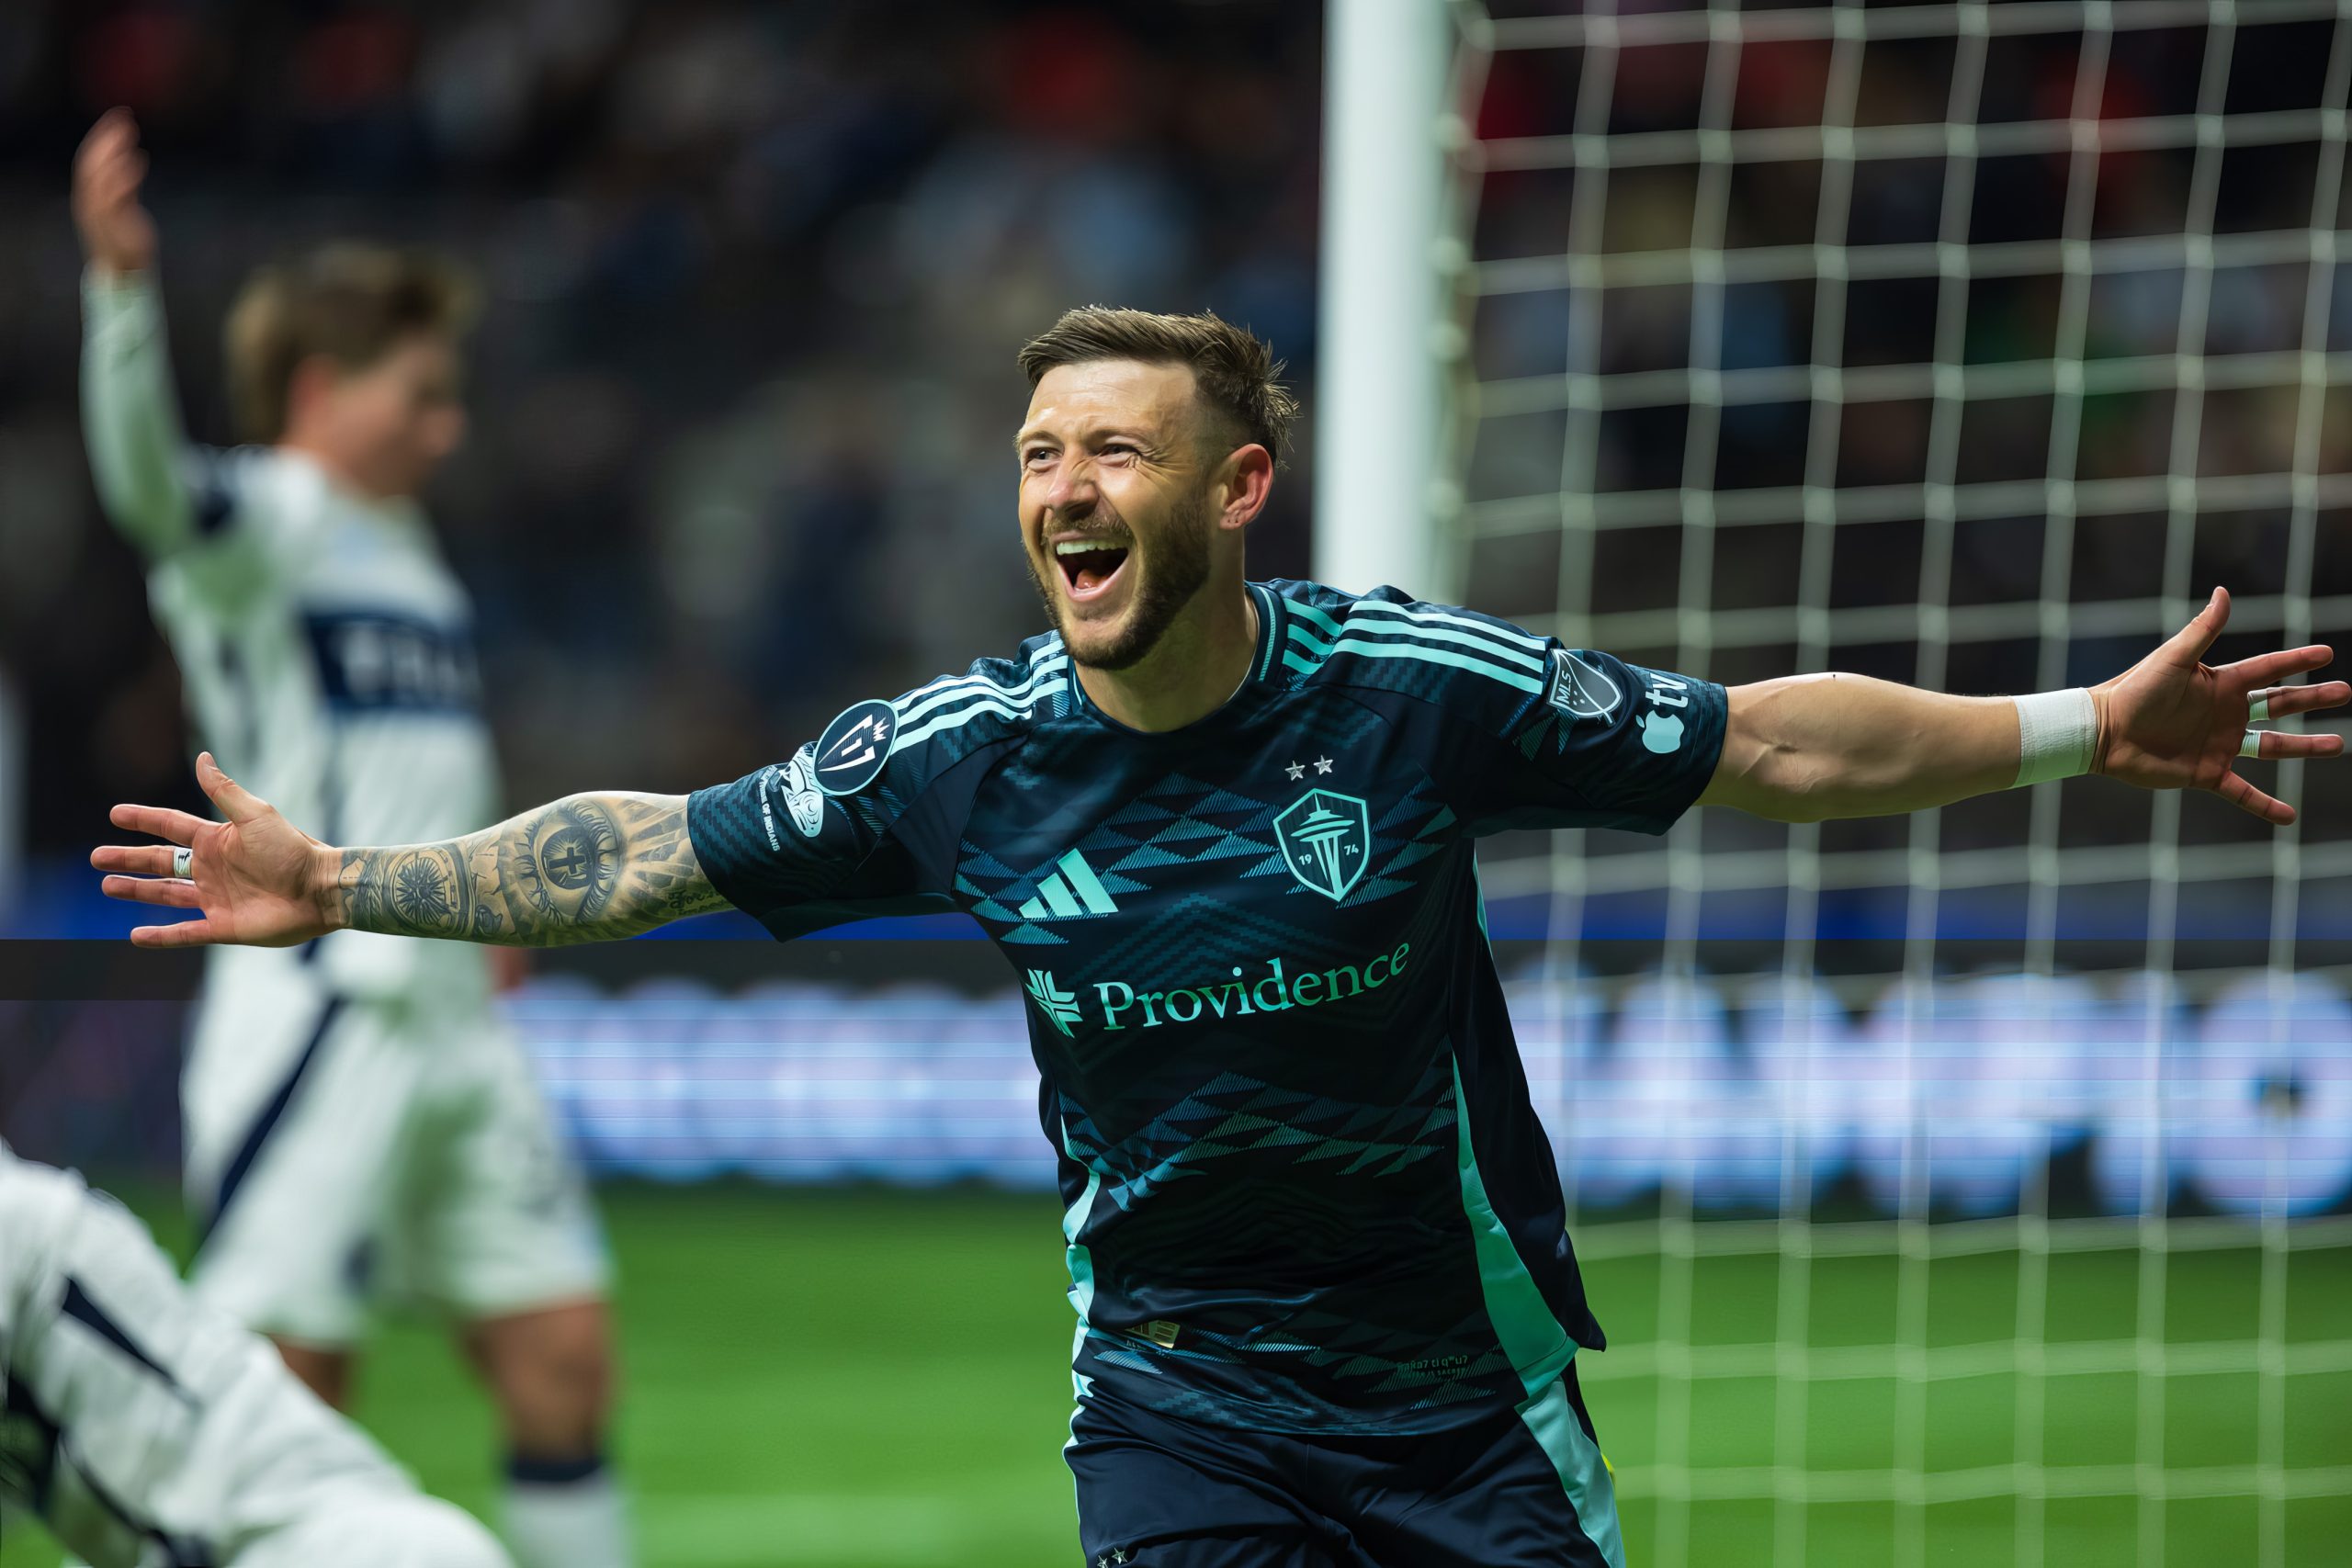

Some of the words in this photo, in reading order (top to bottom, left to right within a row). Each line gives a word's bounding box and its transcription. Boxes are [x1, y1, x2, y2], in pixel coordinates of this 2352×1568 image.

[1555, 670, 1572, 705] MLS
[1645, 672, 1689, 708] tv
[762, 803, 771, 816] OF
[763, 815, 781, 852] INDIANS
[1298, 853, 1312, 866] 19
[1343, 843, 1360, 856] 74
[1093, 942, 1410, 1031] Providence
